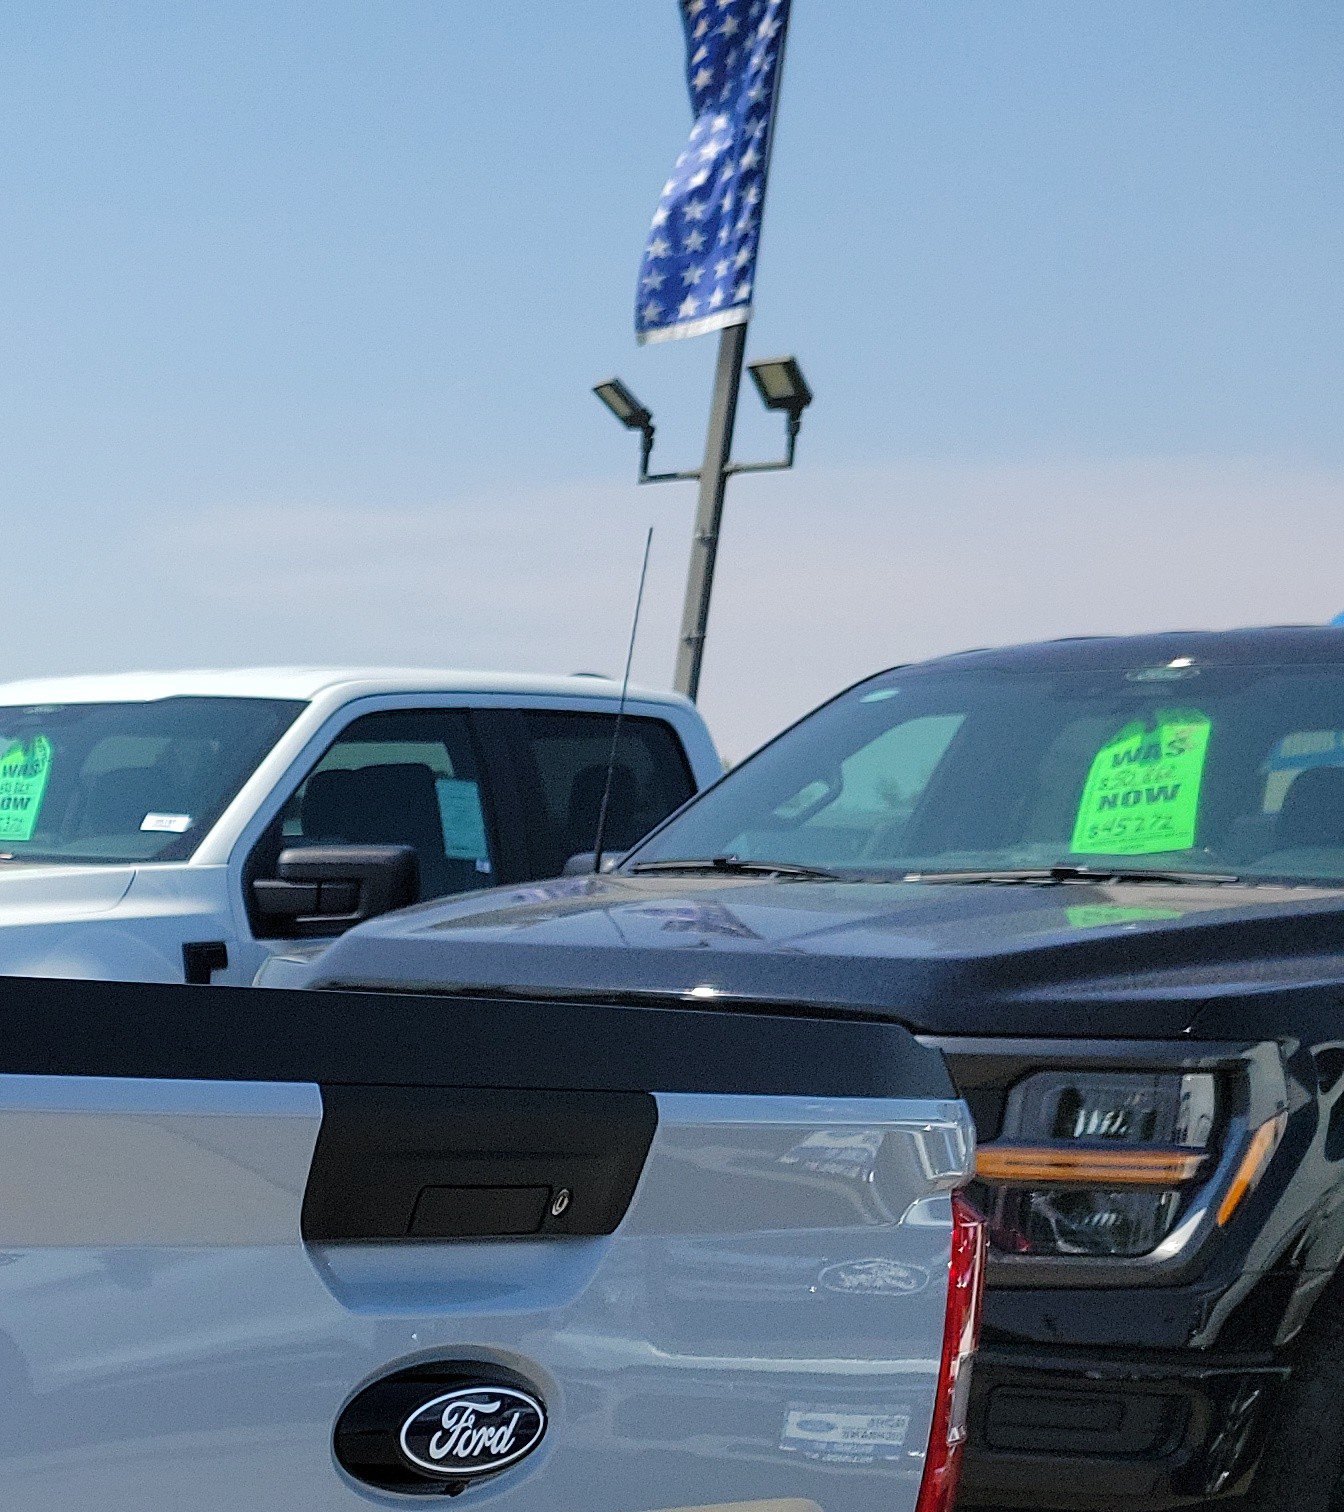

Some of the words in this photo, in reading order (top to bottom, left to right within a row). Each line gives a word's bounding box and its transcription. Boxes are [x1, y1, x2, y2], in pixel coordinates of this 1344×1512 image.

[1111, 737, 1186, 768] WAS
[2, 762, 41, 779] WAS
[1097, 783, 1182, 811] NOW
[429, 1399, 520, 1460] Ford
